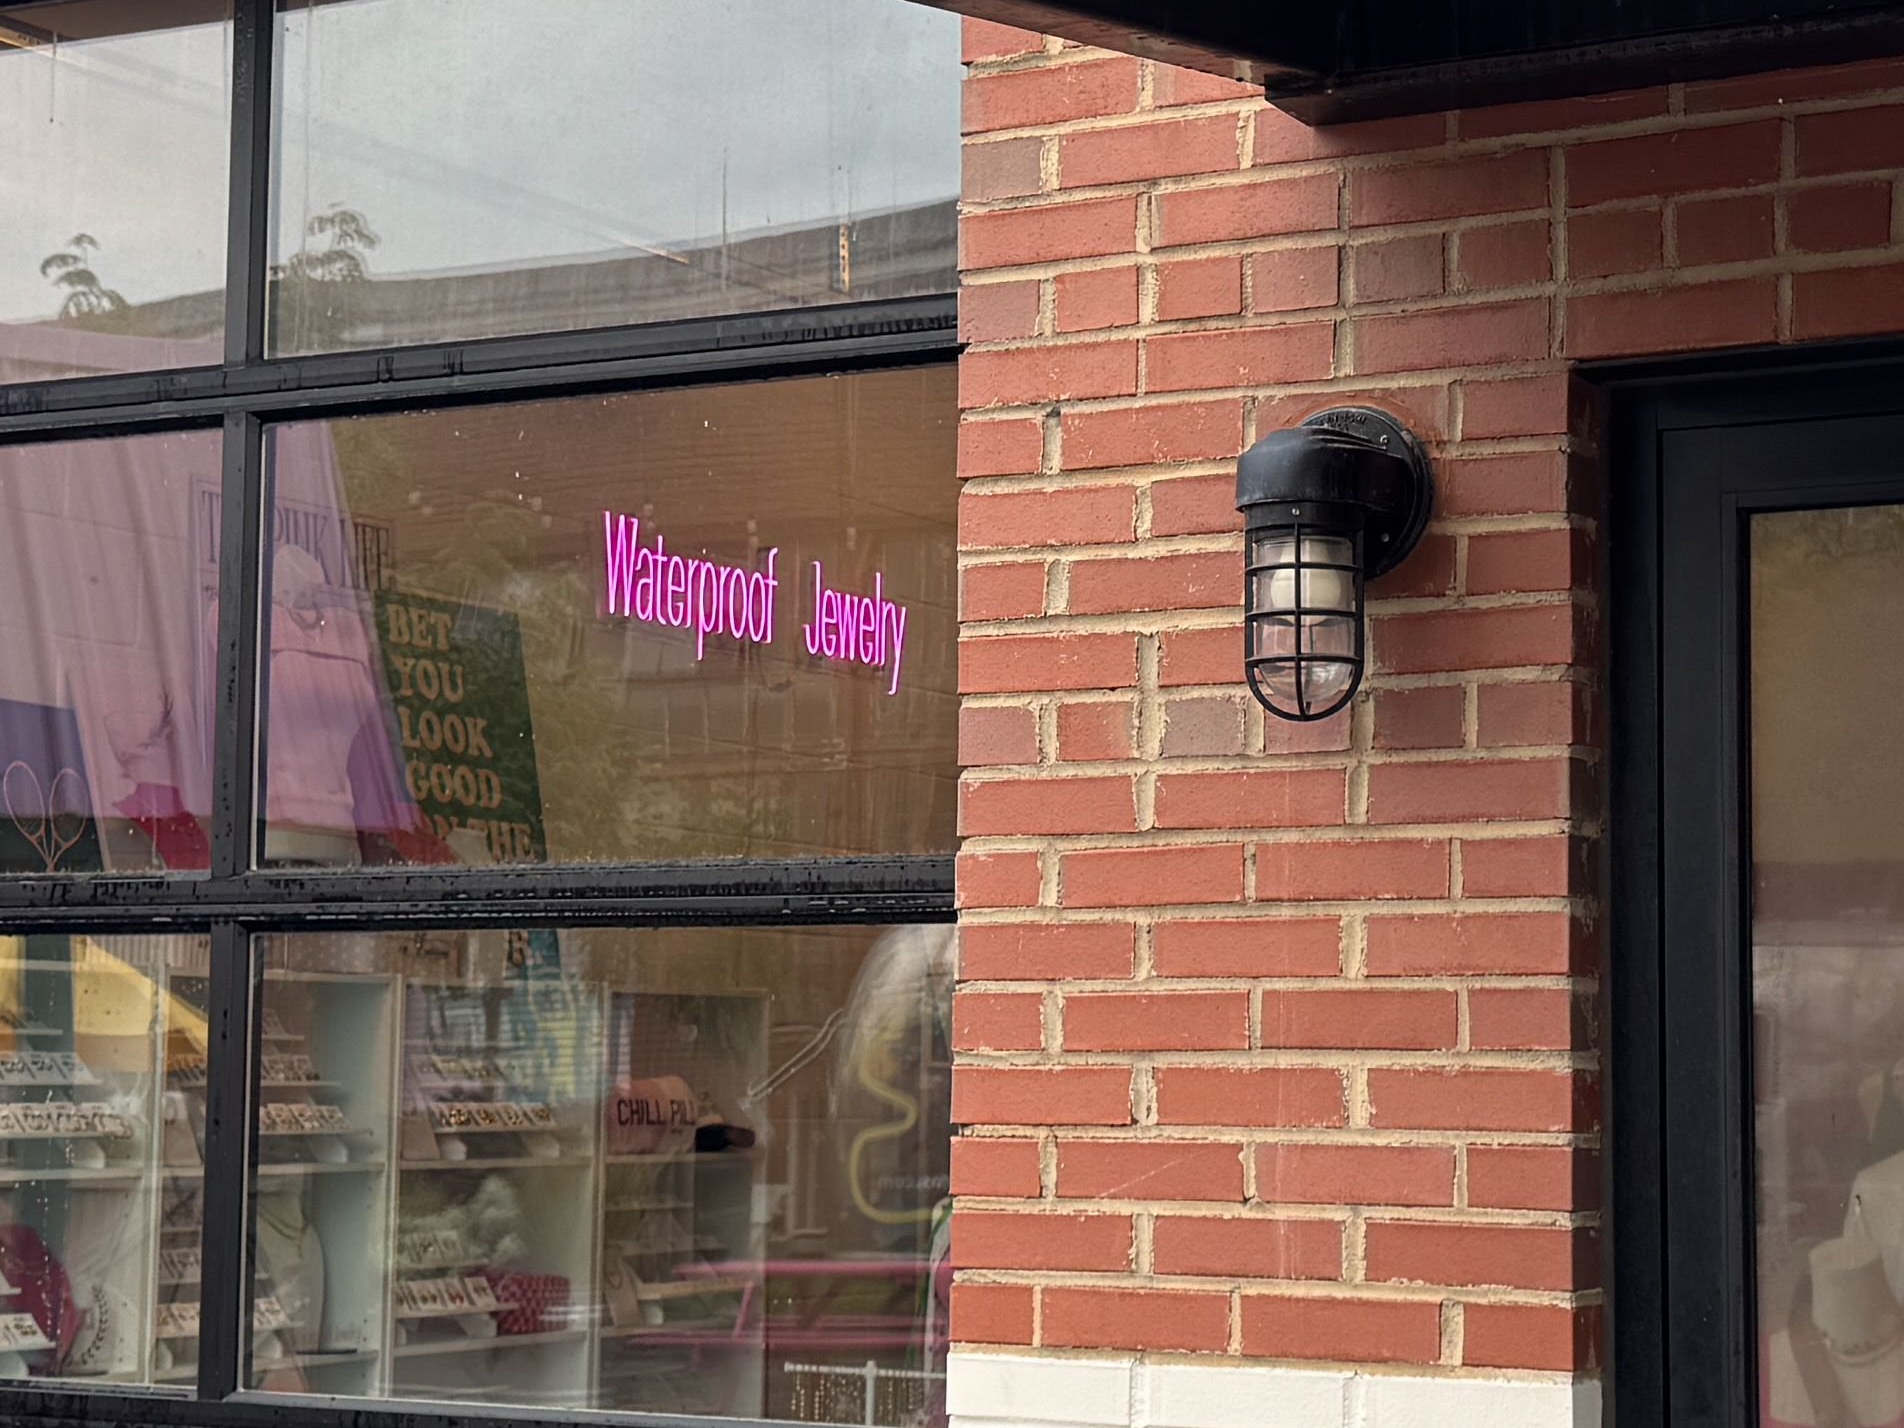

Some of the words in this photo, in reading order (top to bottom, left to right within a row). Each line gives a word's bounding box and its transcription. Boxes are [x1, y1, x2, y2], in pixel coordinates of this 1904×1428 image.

[386, 603, 453, 652] BET
[602, 510, 779, 661] Waterproof
[802, 560, 907, 695] Jewelry
[390, 654, 464, 703] YOU
[398, 705, 494, 759] LOOK
[405, 759, 503, 810] GOOD
[616, 1097, 667, 1126] CHILL
